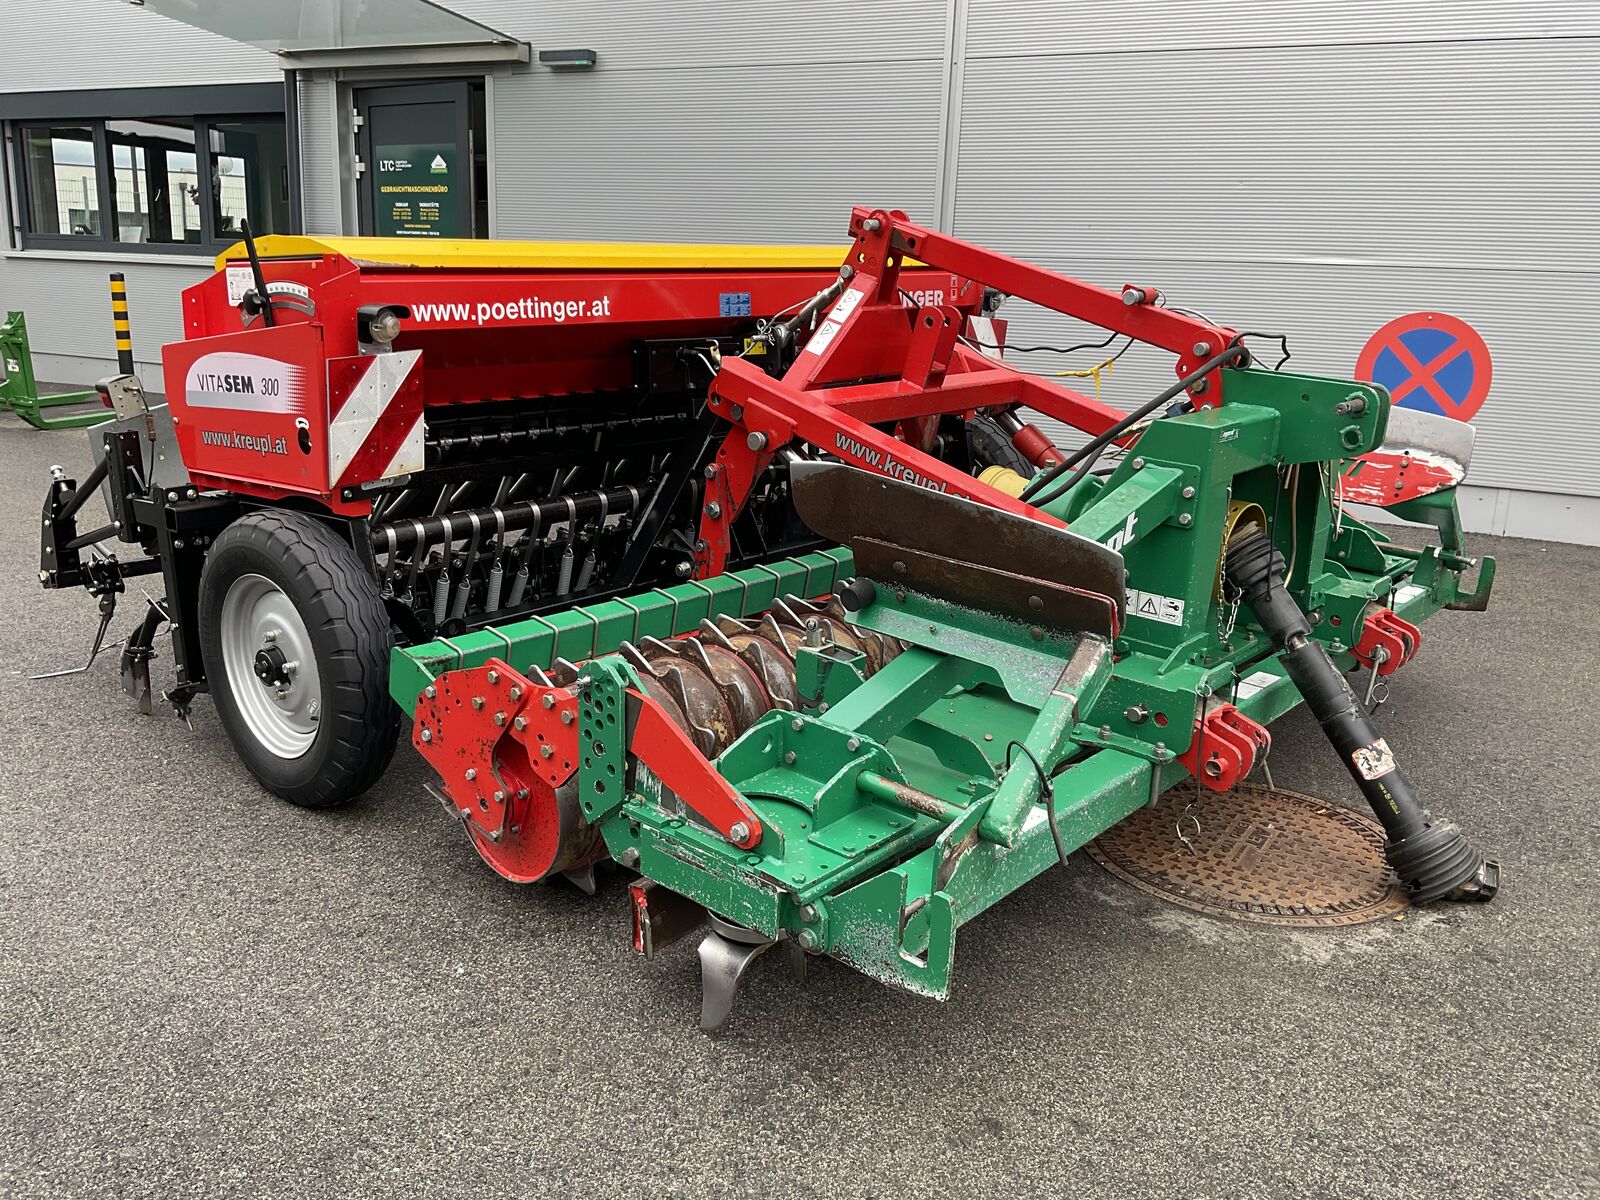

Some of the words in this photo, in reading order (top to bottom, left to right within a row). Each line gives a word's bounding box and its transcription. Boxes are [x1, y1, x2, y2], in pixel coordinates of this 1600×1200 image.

[380, 160, 394, 172] LTC
[412, 295, 610, 326] www.poettinger.at
[197, 373, 254, 395] VITASEM
[261, 378, 279, 397] 300
[201, 428, 288, 457] www.kreupl.at
[834, 431, 972, 501] www.kreupl
